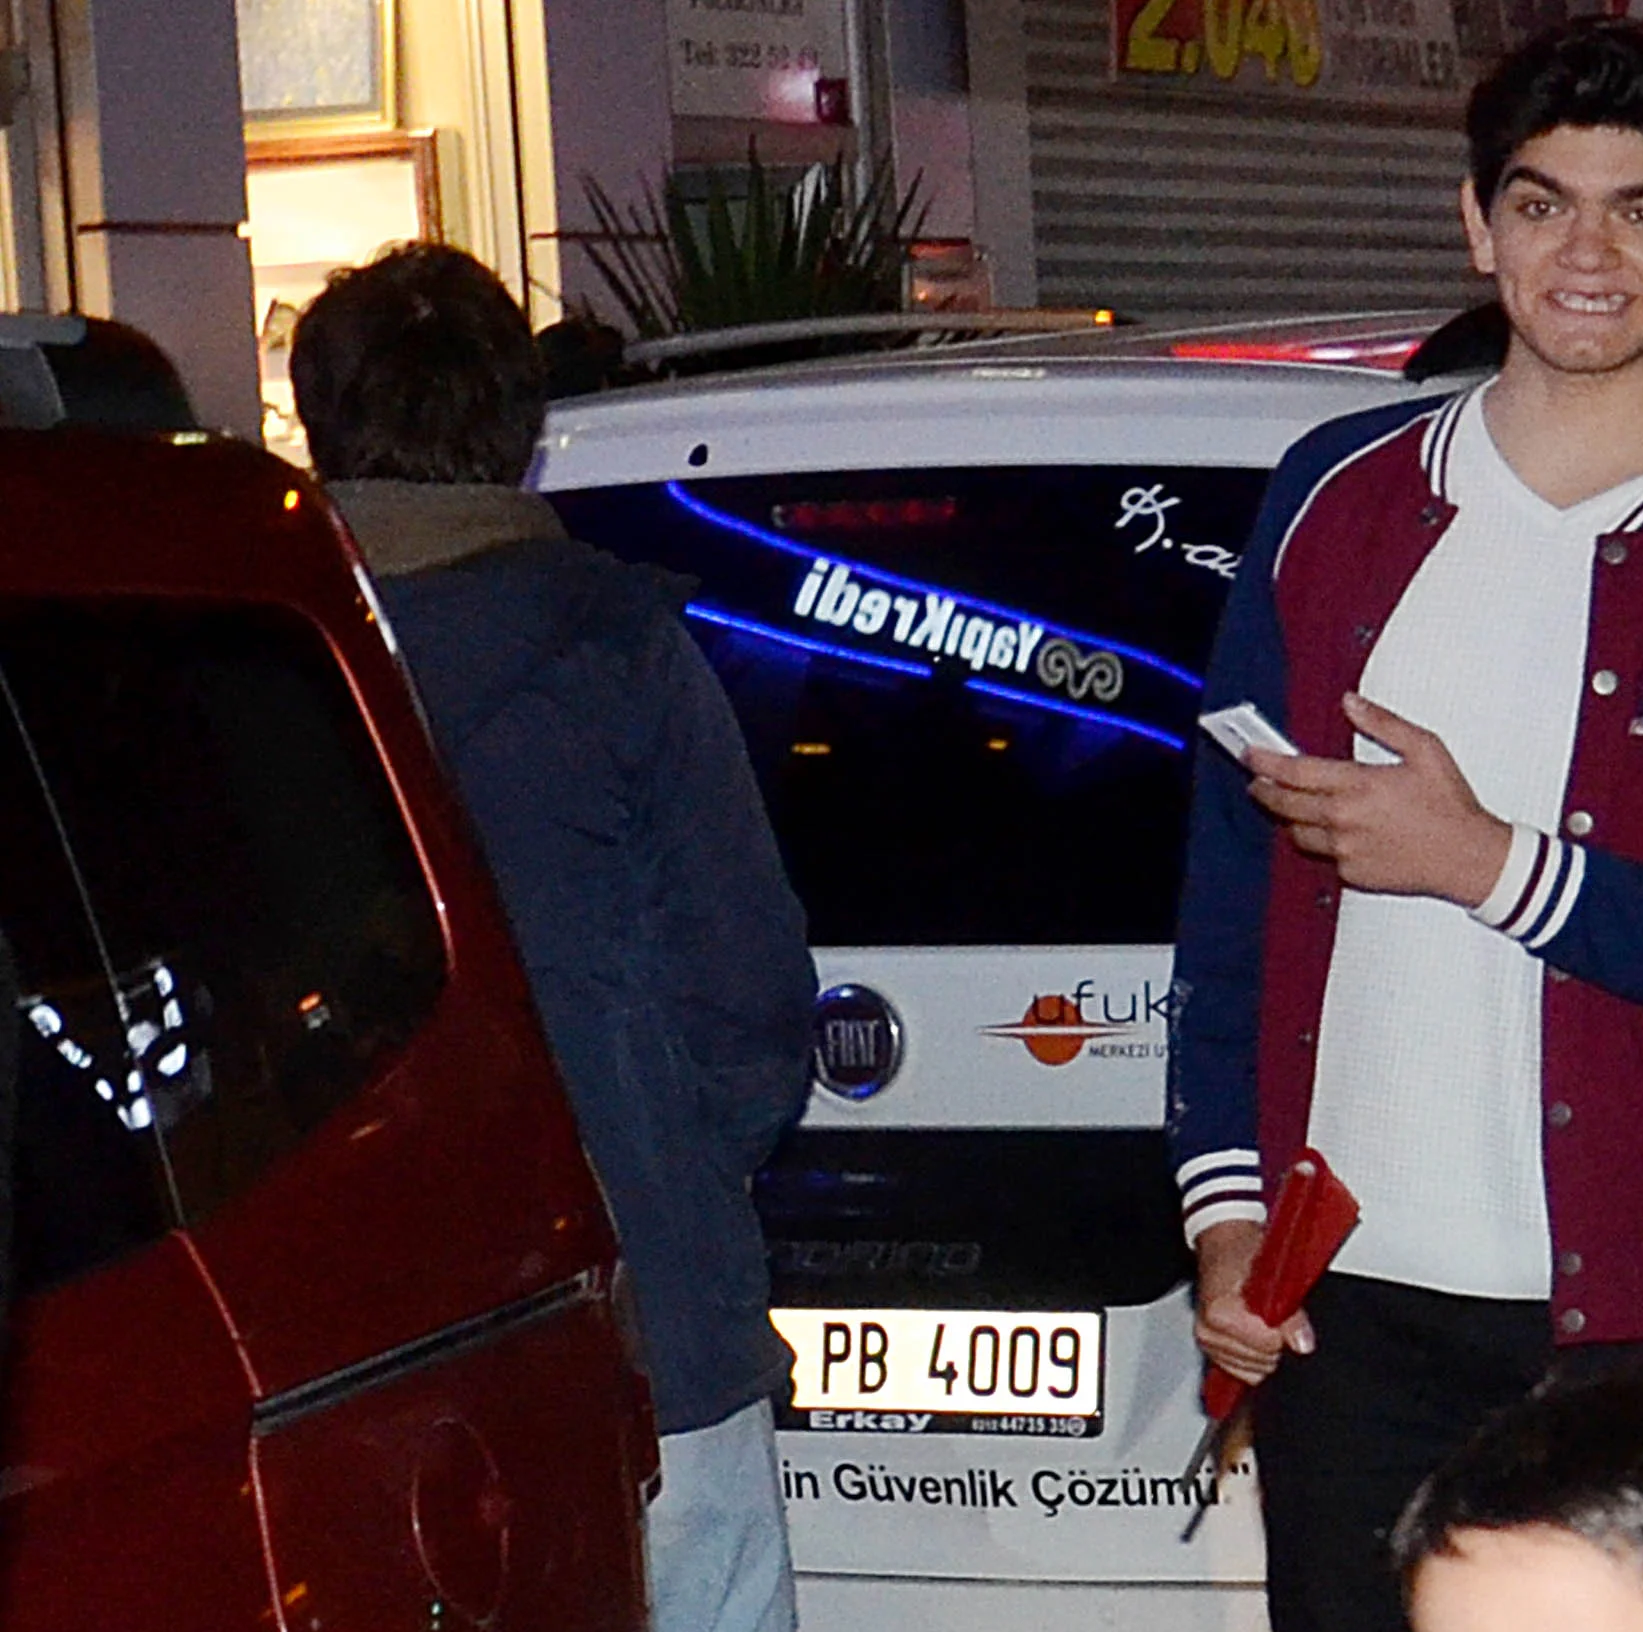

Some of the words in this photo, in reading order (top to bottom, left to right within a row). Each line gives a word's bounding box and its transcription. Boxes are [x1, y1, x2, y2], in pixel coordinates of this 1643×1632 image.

[824, 1018, 881, 1068] FIAT
[822, 1321, 889, 1395] PB
[928, 1322, 1081, 1400] 4009
[808, 1410, 936, 1433] Erkay
[782, 1459, 820, 1500] in
[832, 1461, 1018, 1508] Güvenlik
